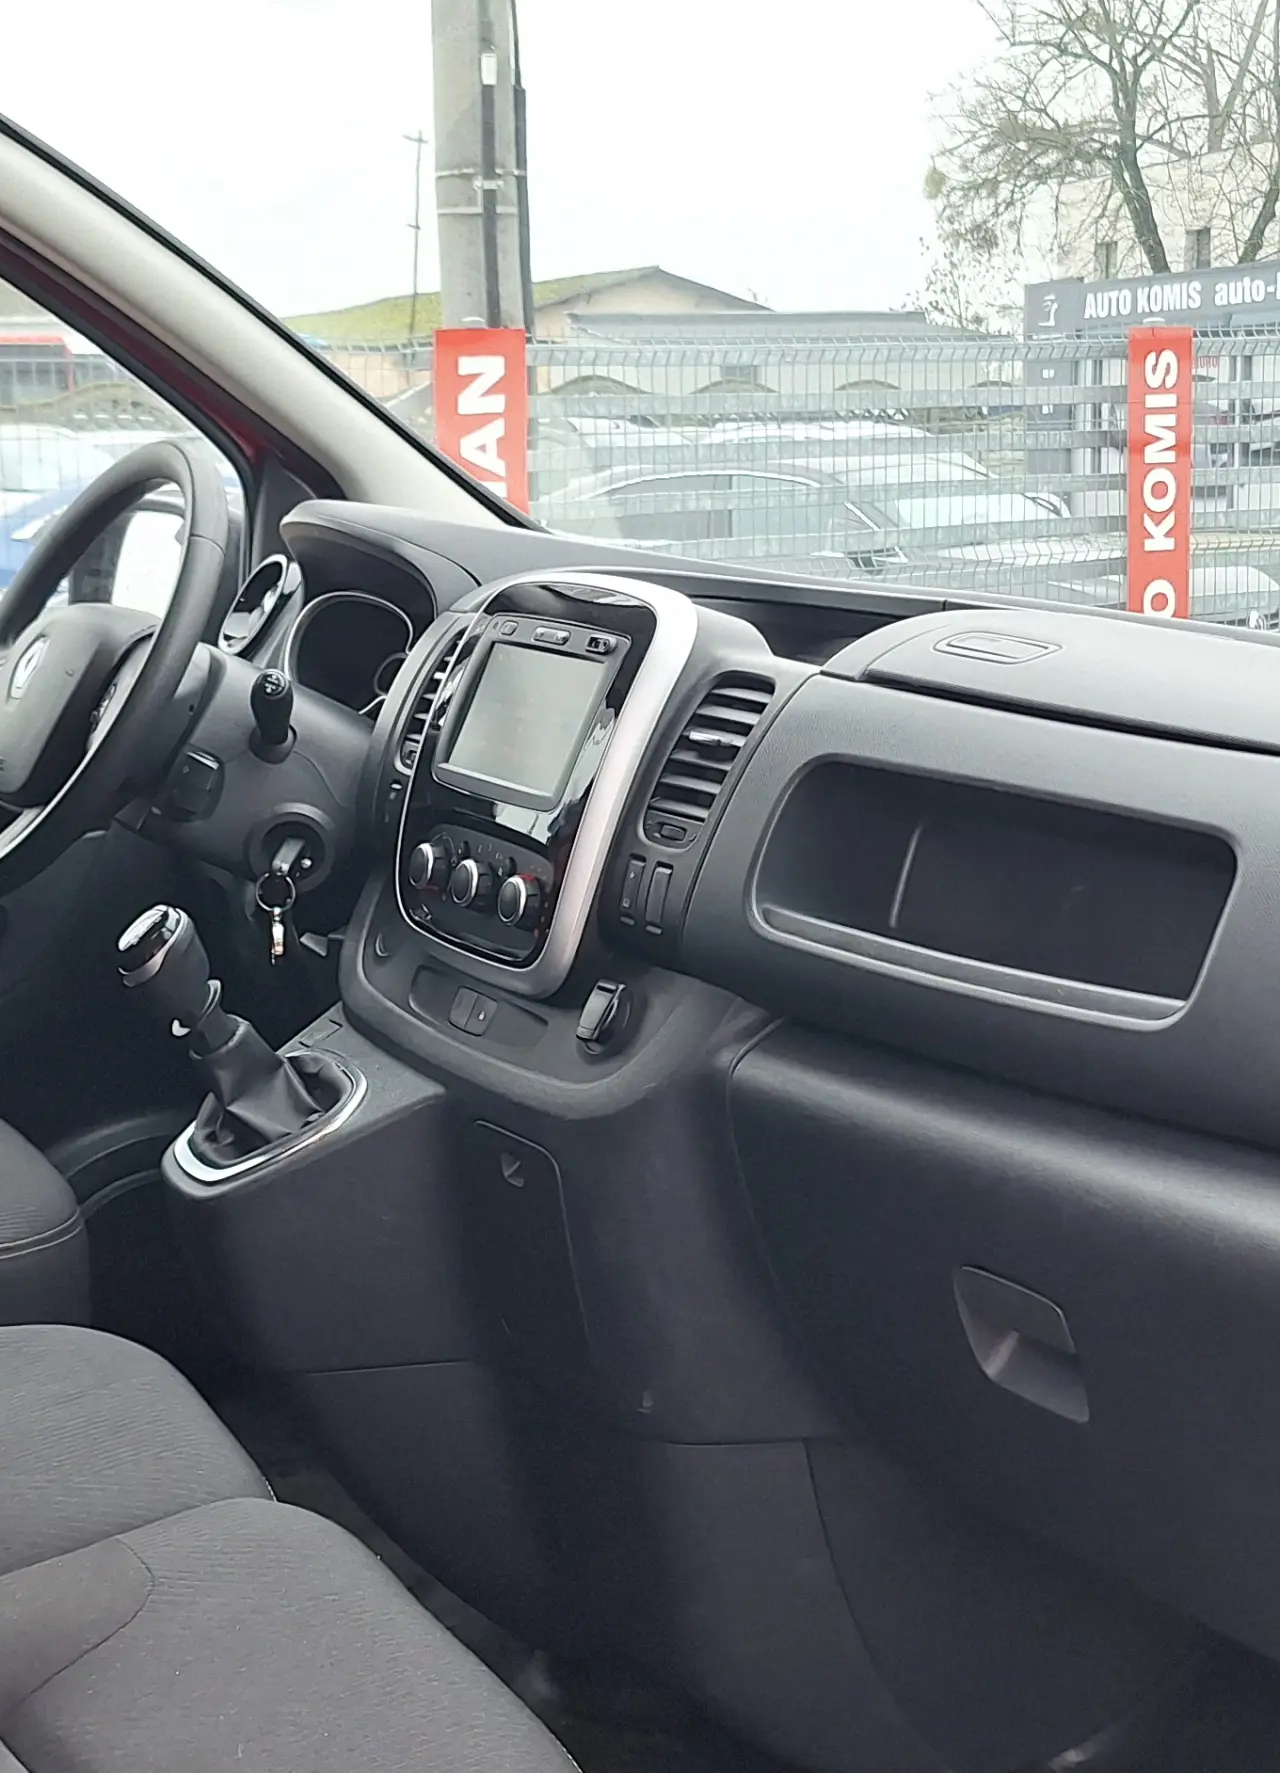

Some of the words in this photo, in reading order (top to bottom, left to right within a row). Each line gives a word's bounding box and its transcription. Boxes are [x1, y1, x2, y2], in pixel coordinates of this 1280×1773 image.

[1083, 288, 1131, 319] AUTO
[1136, 281, 1202, 314] KOMIS
[1142, 348, 1180, 552] KOMIS
